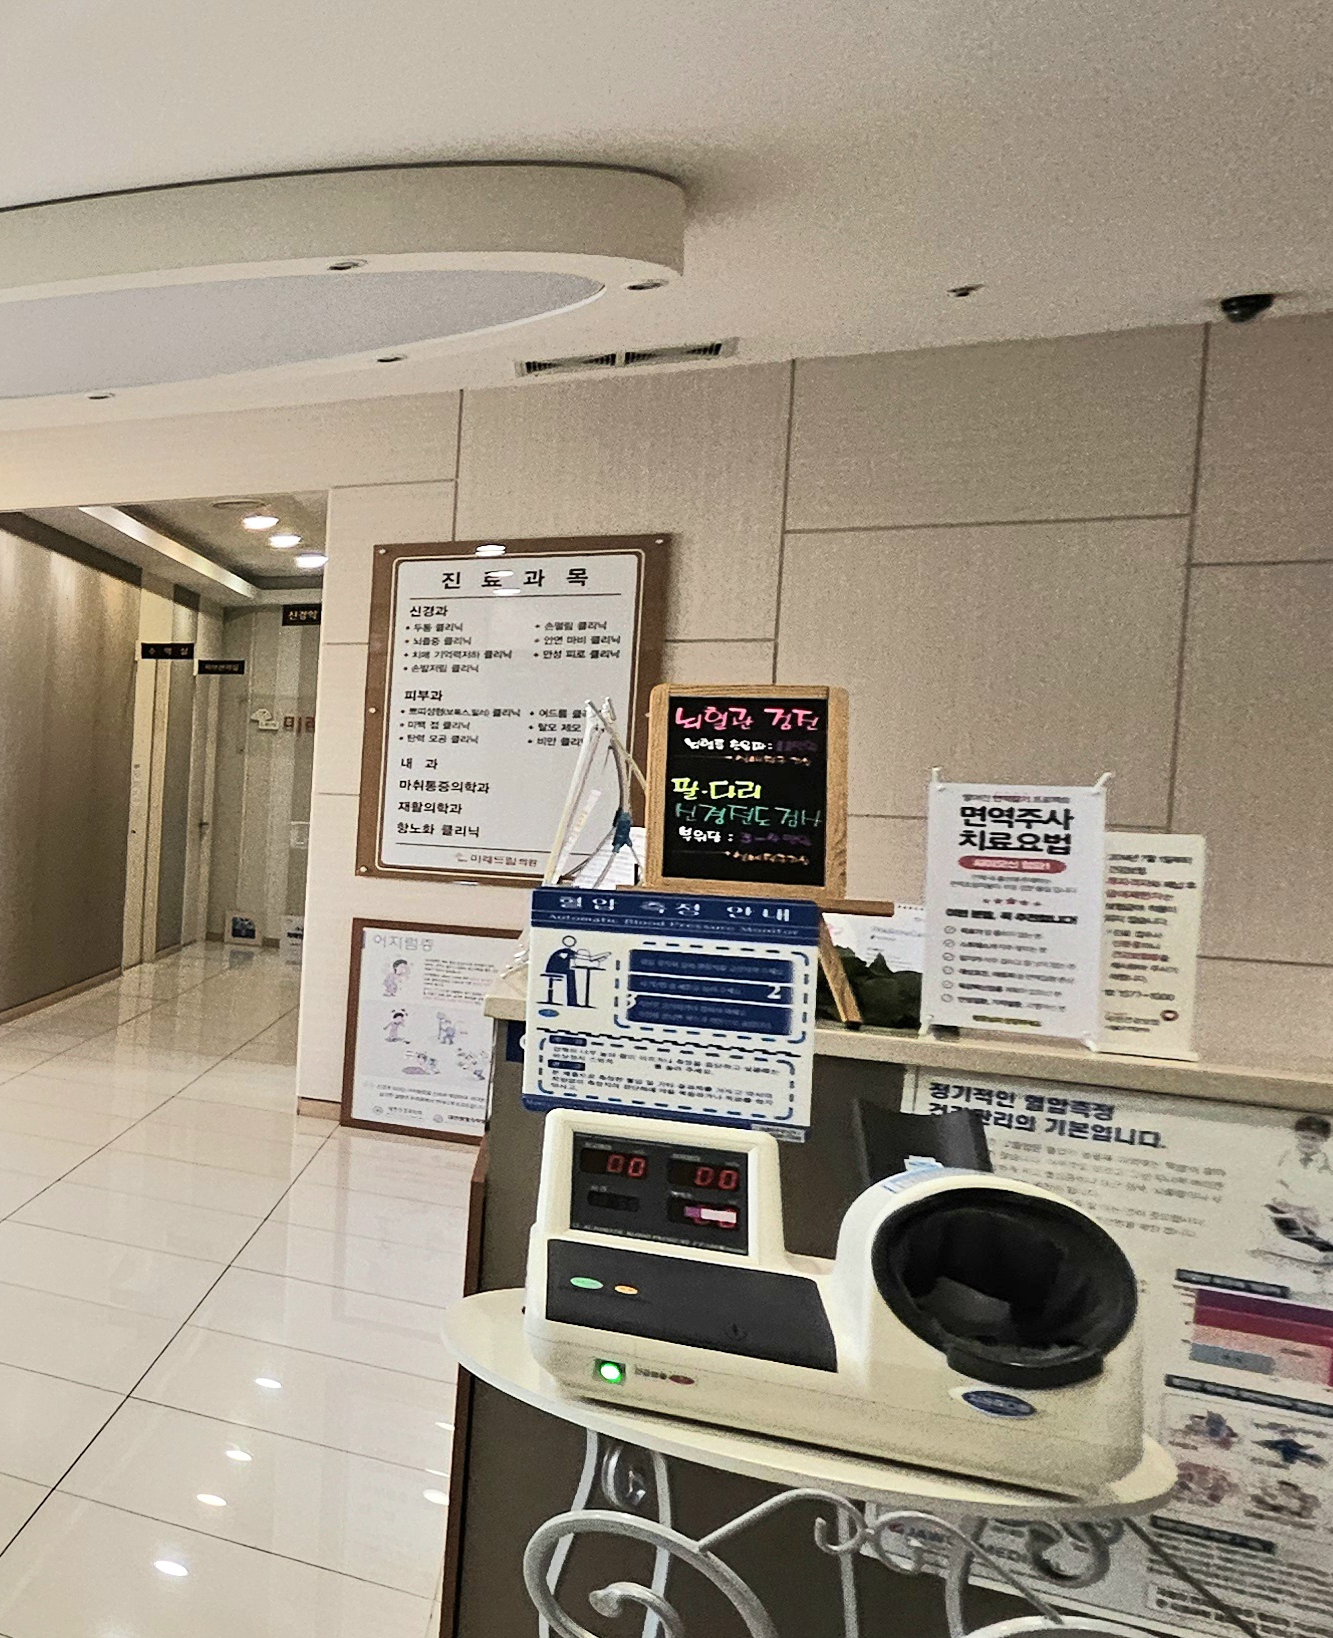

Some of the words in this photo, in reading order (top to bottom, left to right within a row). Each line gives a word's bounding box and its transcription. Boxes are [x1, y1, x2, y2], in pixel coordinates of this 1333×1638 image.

[410, 605, 448, 617] 신경과
[404, 690, 443, 701] 피부과
[675, 707, 754, 730] 뇌혈관
[399, 780, 489, 794] 마취통증의학과
[398, 802, 462, 814] 재활의학과
[960, 806, 1074, 830] 면역주사
[442, 824, 479, 838] 클리닉
[959, 830, 1071, 855] 치료요법
[929, 1083, 1017, 1108] 정기적인
[1024, 1094, 1114, 1121] 혈압측정
